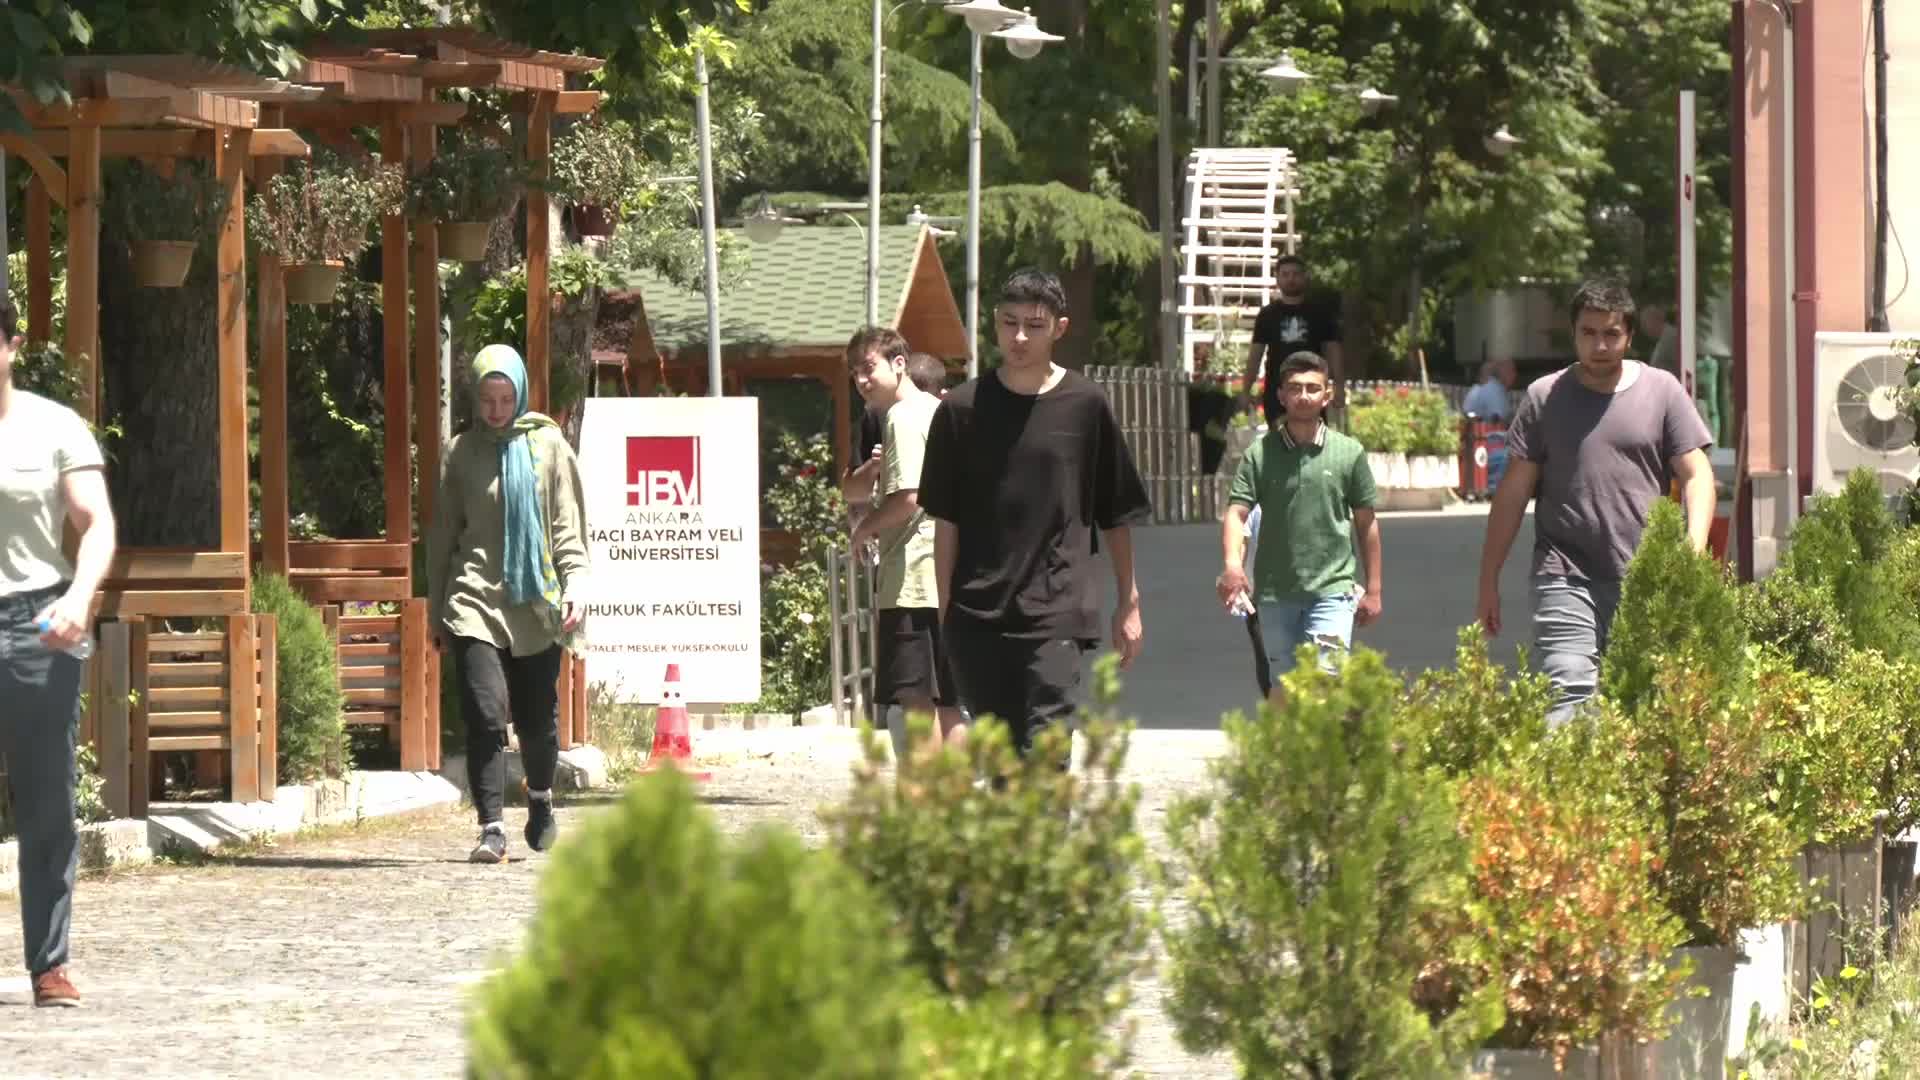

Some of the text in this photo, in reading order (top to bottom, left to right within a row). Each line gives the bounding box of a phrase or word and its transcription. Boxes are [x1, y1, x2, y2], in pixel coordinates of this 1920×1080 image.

[625, 511, 703, 524] ANKARA
[630, 529, 702, 541] BAYRAM
[708, 526, 743, 541] VELİ
[609, 544, 719, 560] ÜNİVERSİTESİ
[588, 599, 742, 616] HUKUK FAKÜLTESİ
[627, 644, 668, 653] MESLEK
